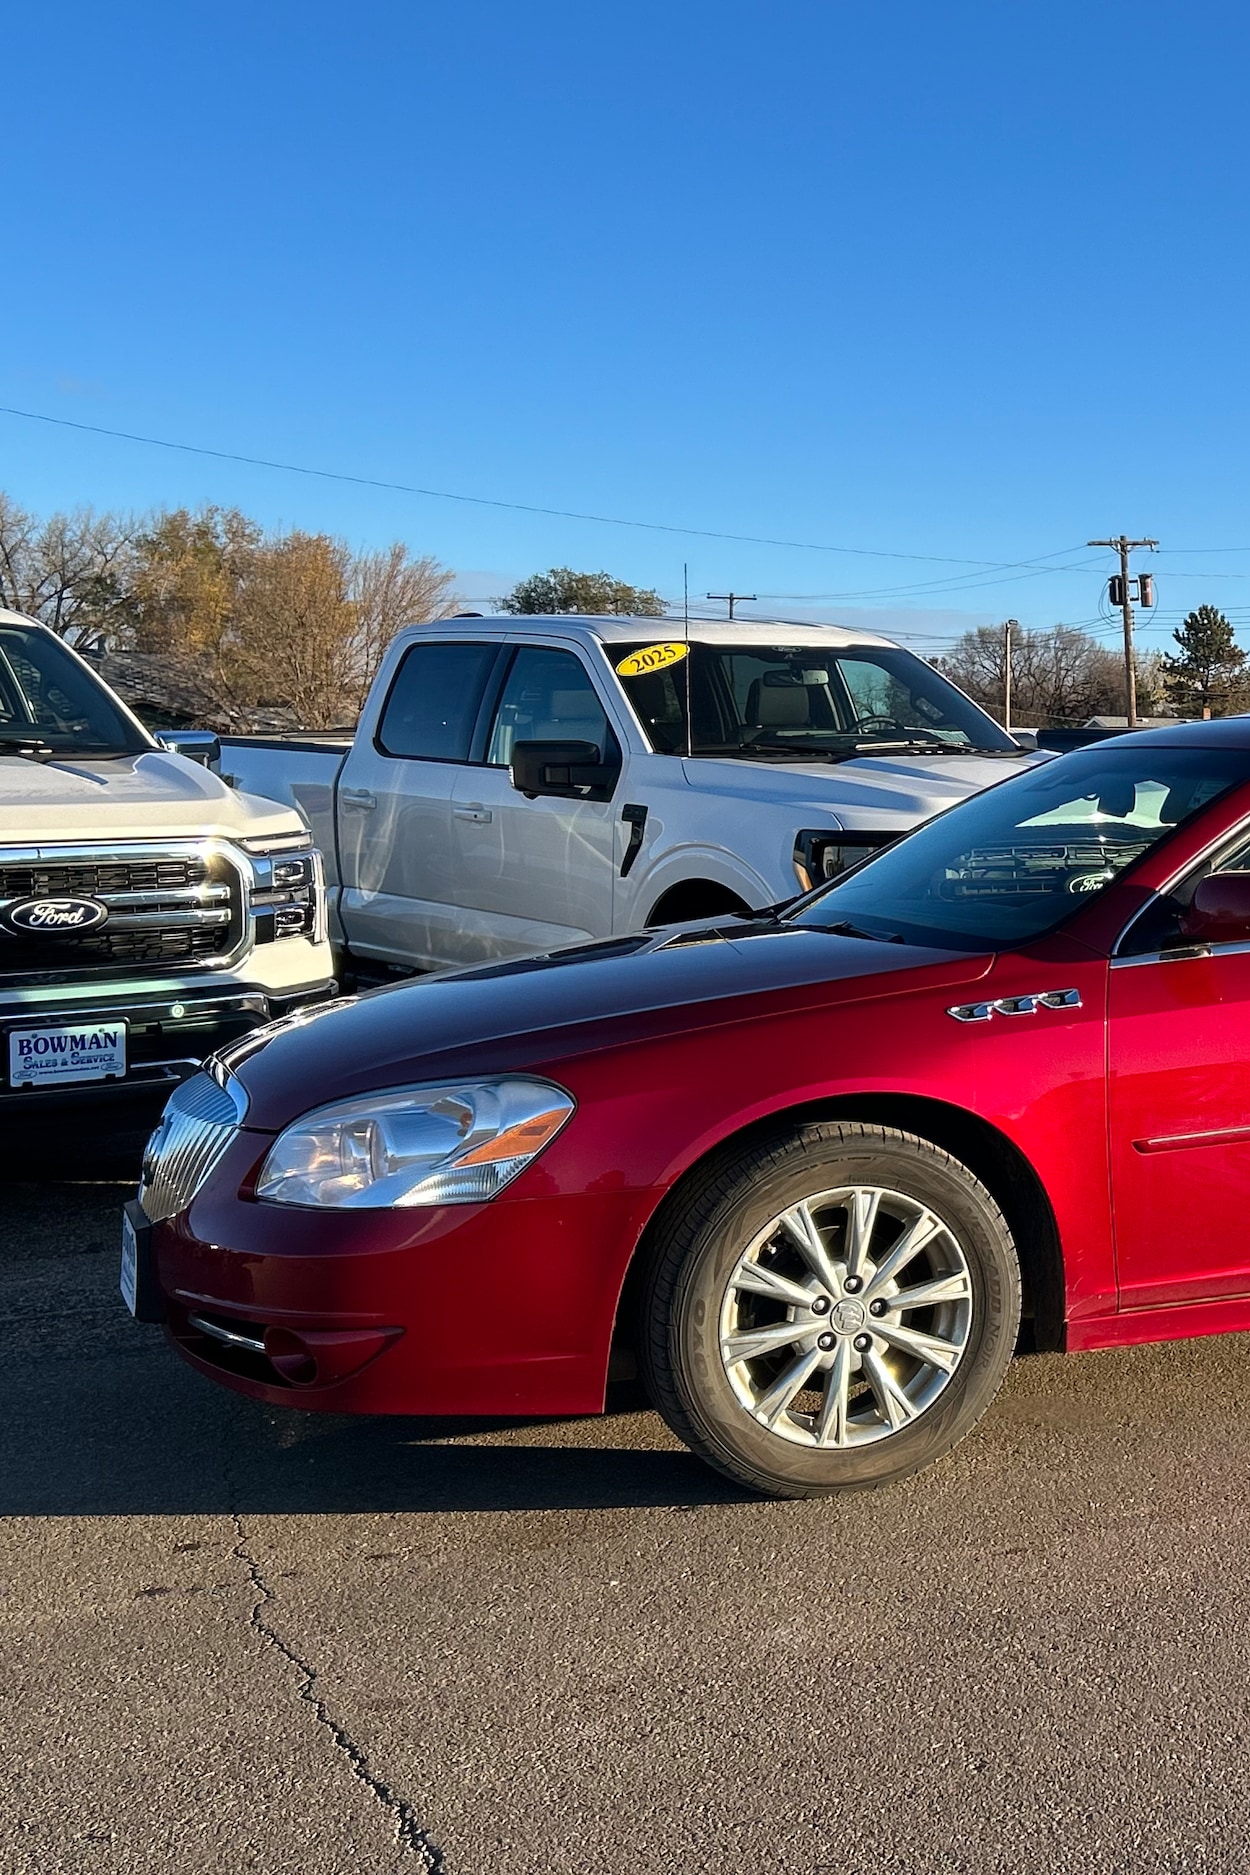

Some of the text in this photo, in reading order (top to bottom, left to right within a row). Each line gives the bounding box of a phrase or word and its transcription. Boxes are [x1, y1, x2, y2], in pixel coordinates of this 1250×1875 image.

[630, 645, 677, 672] 2025
[28, 903, 85, 926] Ford
[18, 1032, 118, 1056] BOWMAN
[23, 1052, 116, 1069] SALES & SERVICE
[975, 1321, 1001, 1370] NOIR
